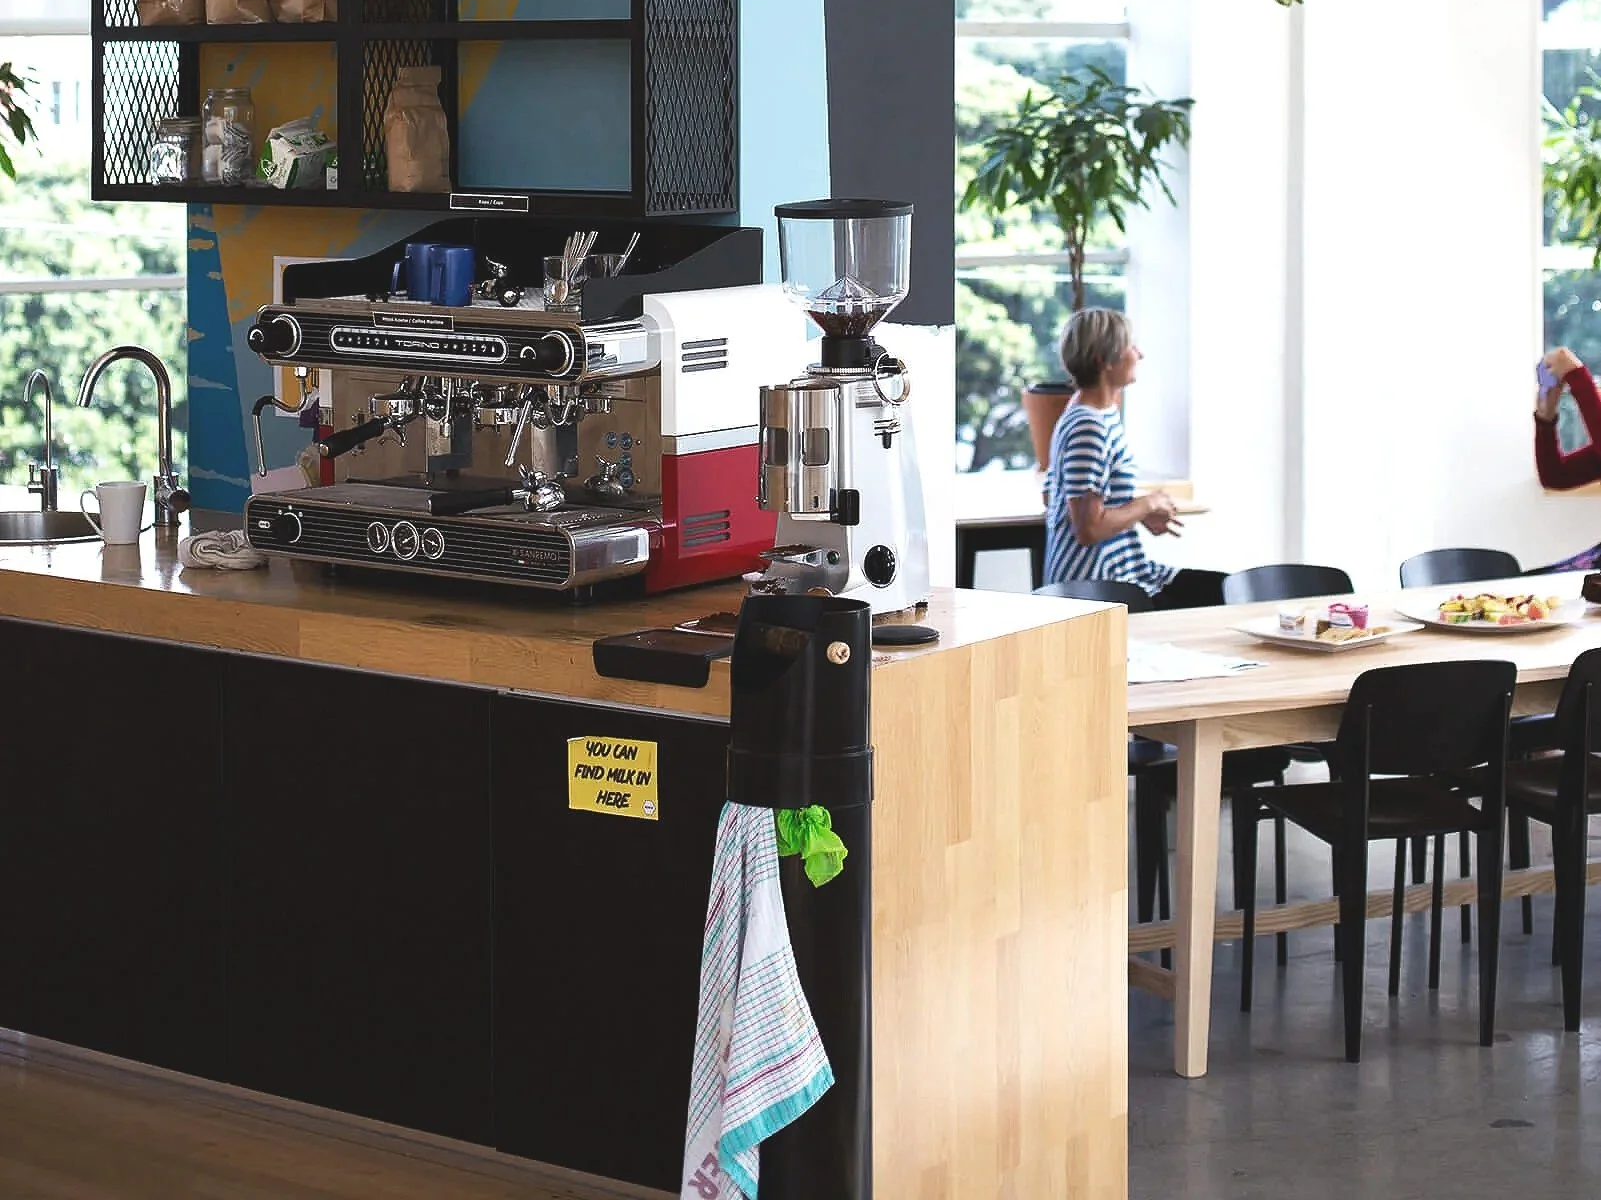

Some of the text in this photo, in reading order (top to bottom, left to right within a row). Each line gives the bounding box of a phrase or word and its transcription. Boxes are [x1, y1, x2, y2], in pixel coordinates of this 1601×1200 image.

[395, 339, 440, 349] TORINO
[586, 740, 638, 760] YOU CAN
[574, 763, 652, 786] FIND MILK IN
[596, 789, 631, 809] HERE
